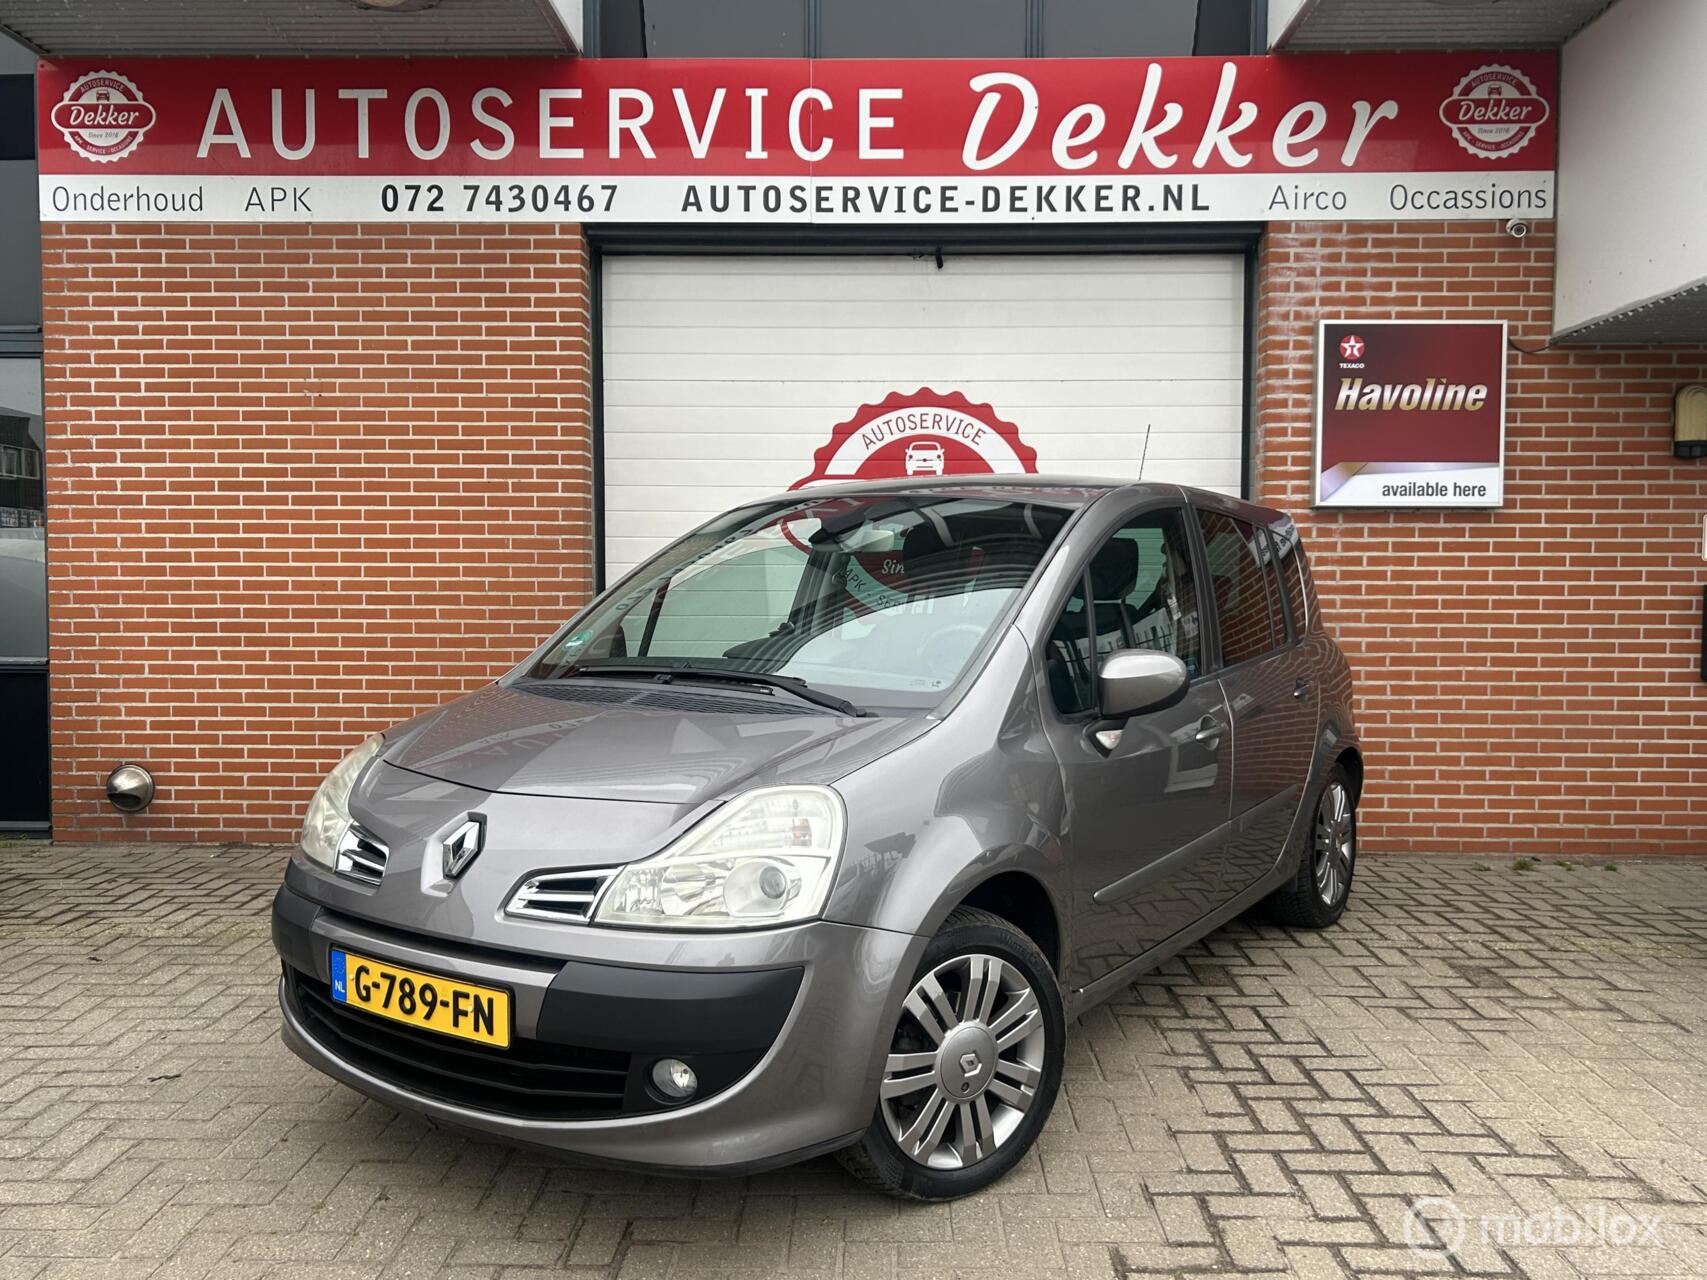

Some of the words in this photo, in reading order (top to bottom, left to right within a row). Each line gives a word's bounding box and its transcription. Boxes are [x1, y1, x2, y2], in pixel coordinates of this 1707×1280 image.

[80, 79, 125, 93] AUTOSERVICE
[69, 104, 139, 125] Dekker
[197, 88, 904, 161] AUTOSERVICE
[962, 62, 1398, 171] Dekker
[1459, 99, 1532, 120] Dekker
[52, 186, 204, 212] Onderhoud
[244, 187, 312, 212] APK
[381, 185, 444, 212] 072
[463, 185, 618, 212] 7430467
[681, 184, 1210, 213] AUTOSERVICE-DEKKER.NL
[1268, 185, 1347, 210] Airco
[1390, 184, 1547, 210] Occassions
[1335, 378, 1488, 411] Havoline
[861, 413, 986, 450] AUTOSERVICE
[1382, 482, 1448, 497] available
[1453, 482, 1487, 497] here
[335, 980, 345, 993] NL
[355, 965, 494, 1036] G-789-FN
